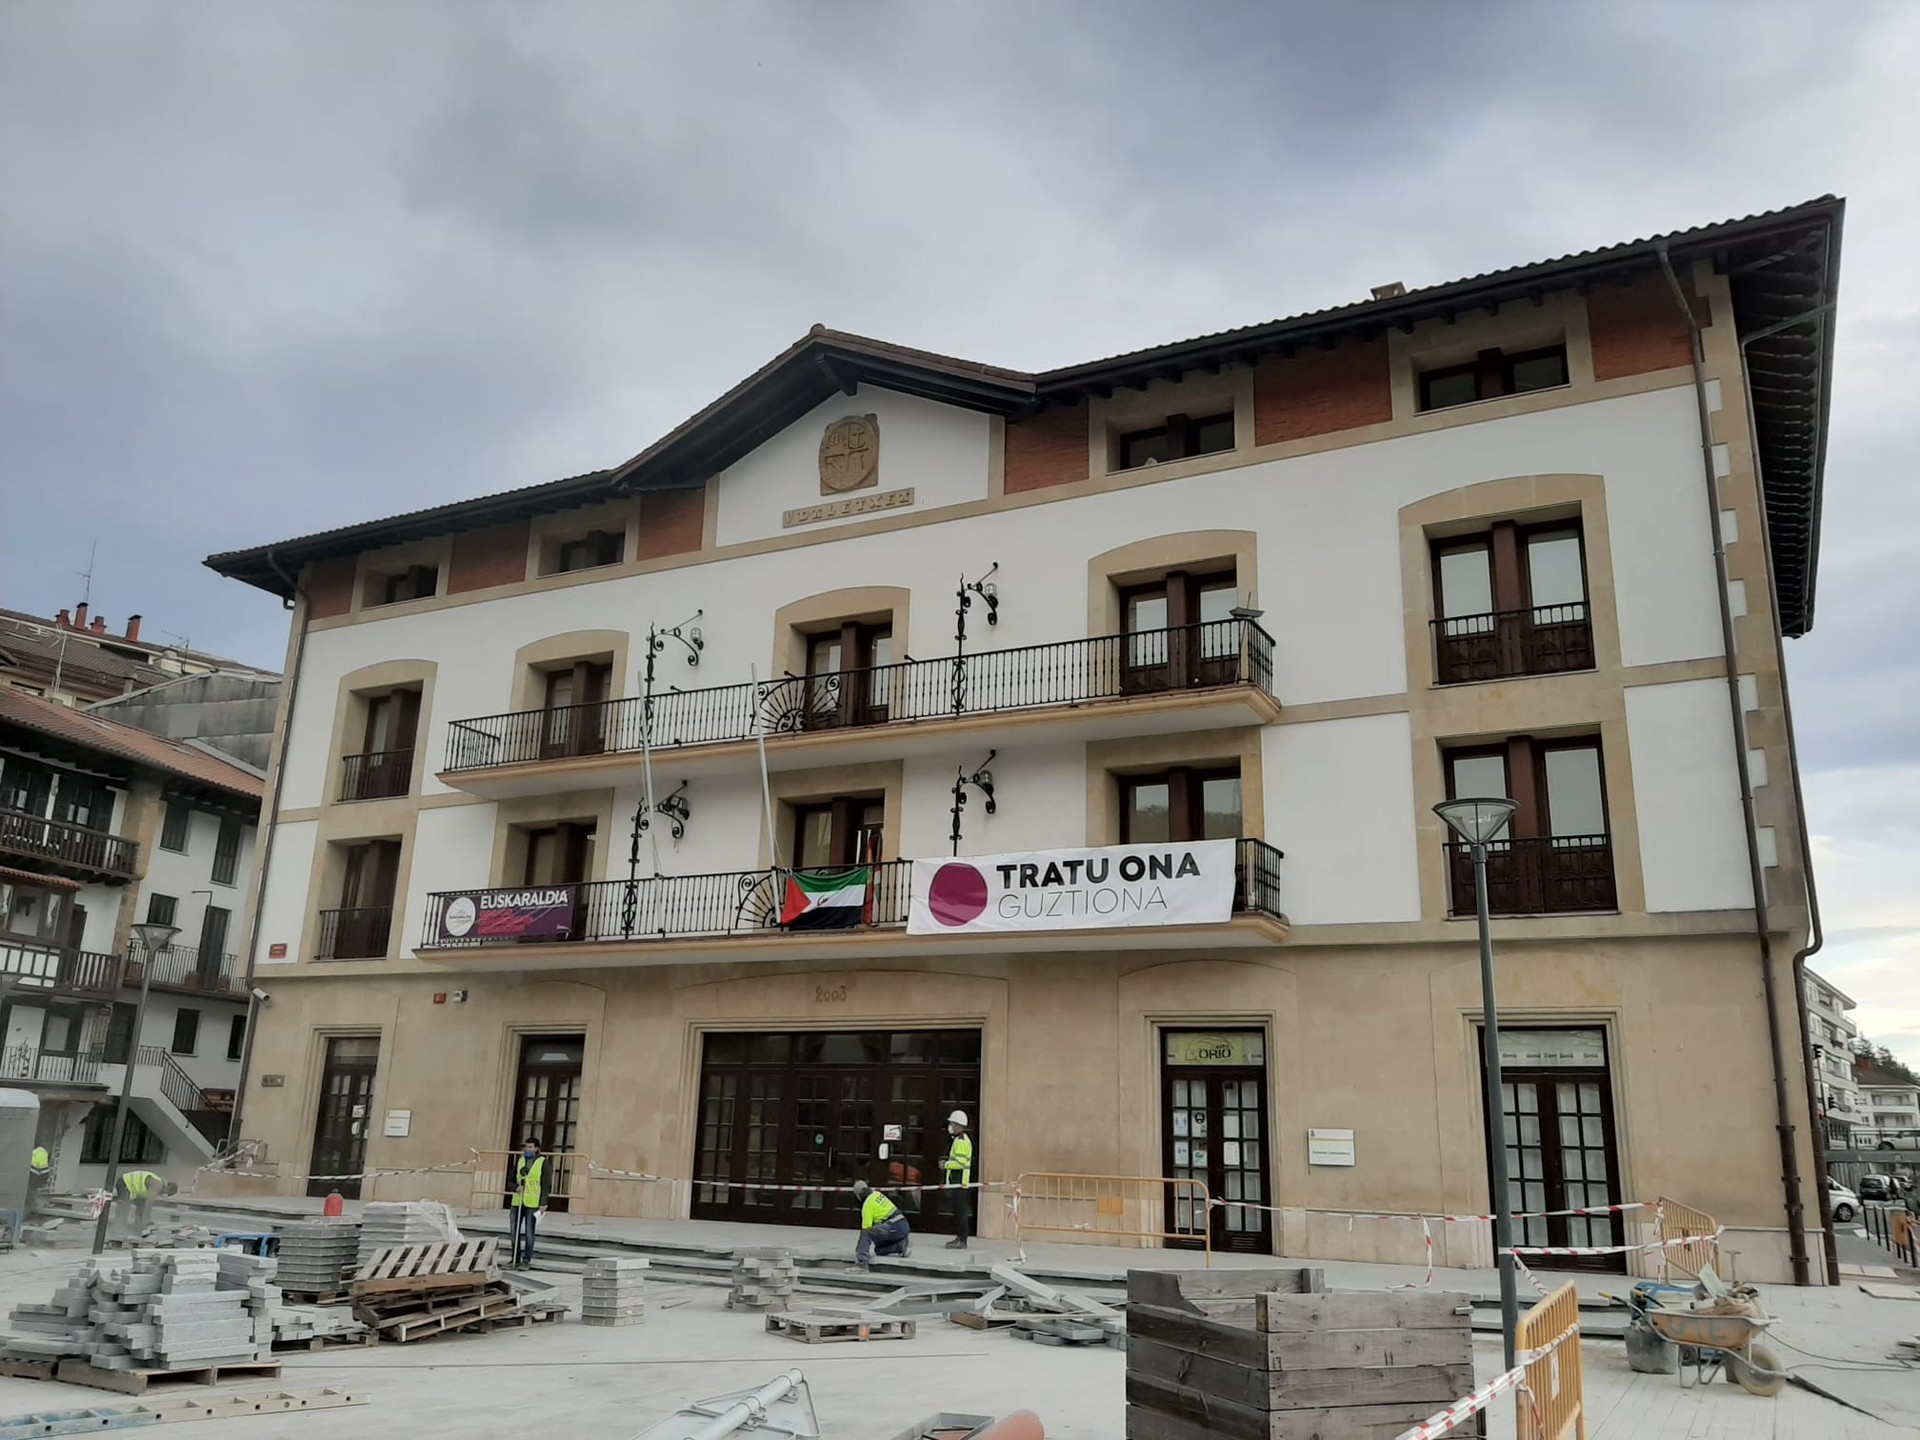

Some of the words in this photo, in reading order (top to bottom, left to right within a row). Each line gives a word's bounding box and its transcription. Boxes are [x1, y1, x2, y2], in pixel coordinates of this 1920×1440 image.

[996, 856, 1110, 889] TRATU
[1118, 852, 1201, 882] ONA
[480, 889, 568, 909] EUSKARALDIA
[998, 886, 1168, 919] GUZTIONA
[815, 984, 847, 1003] 2003
[1198, 1048, 1232, 1060] ORIO
